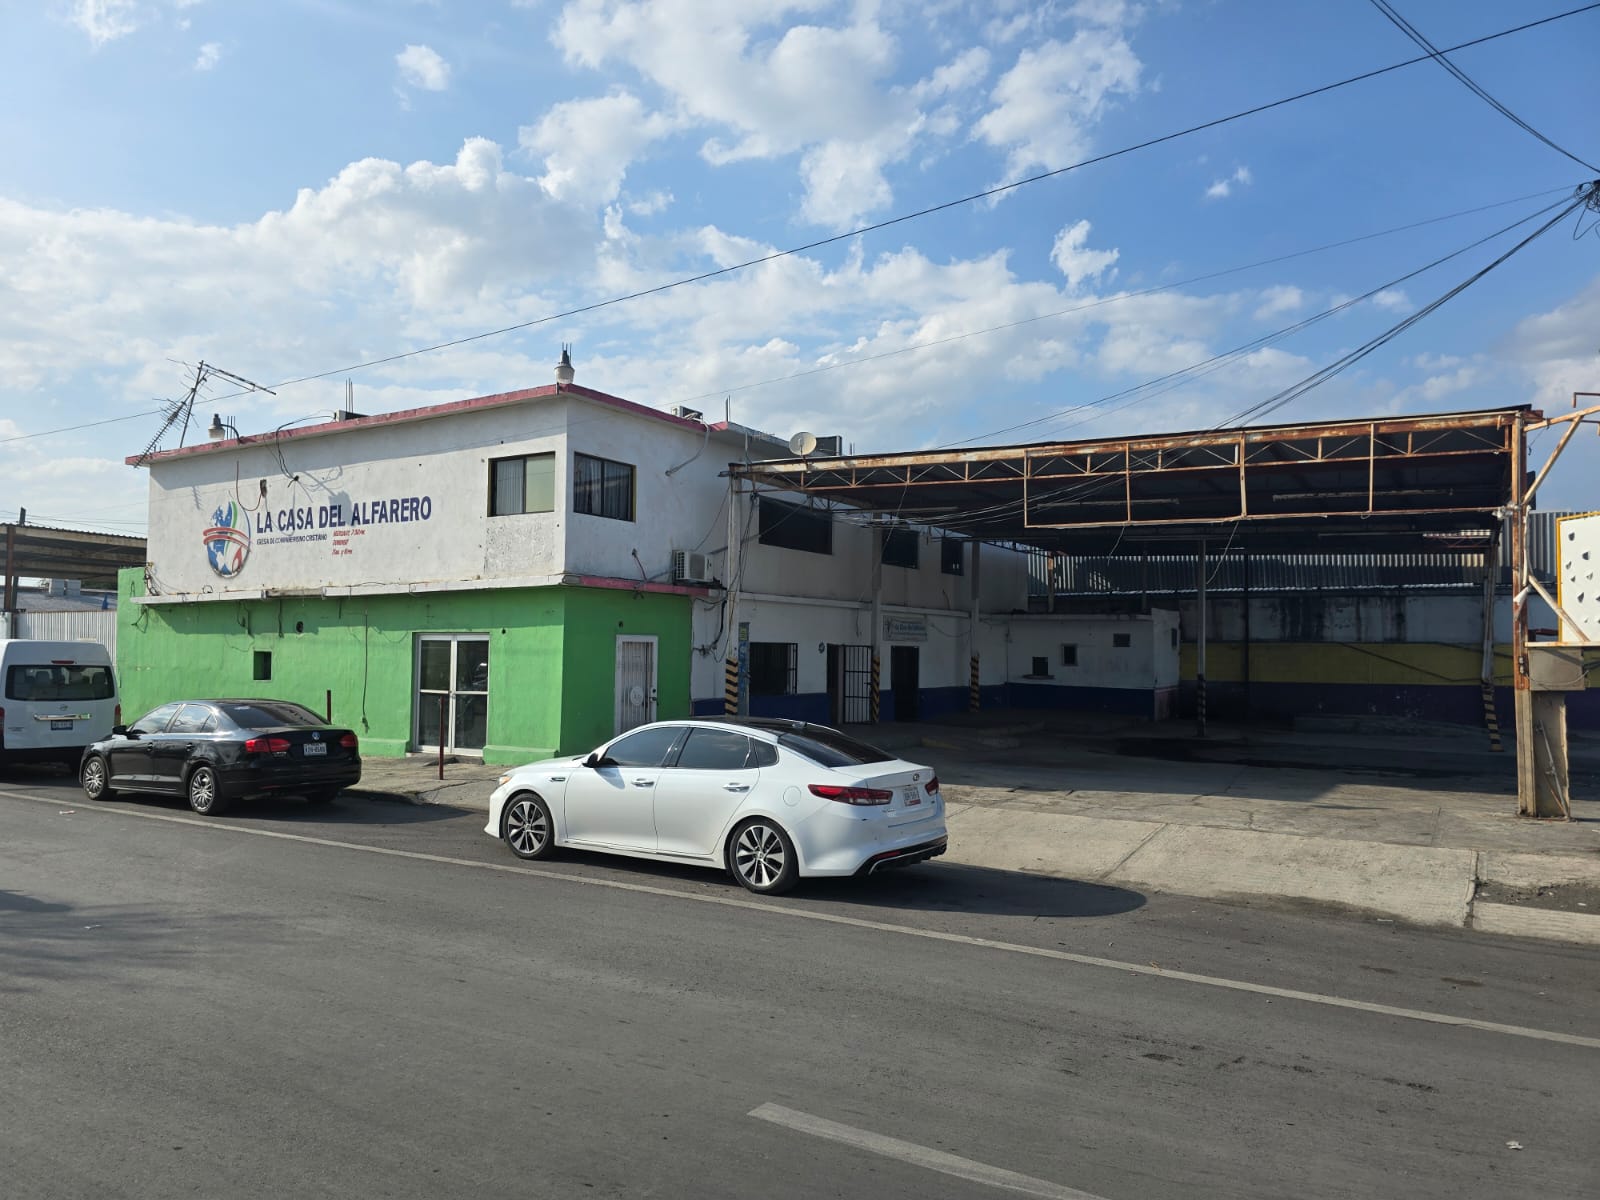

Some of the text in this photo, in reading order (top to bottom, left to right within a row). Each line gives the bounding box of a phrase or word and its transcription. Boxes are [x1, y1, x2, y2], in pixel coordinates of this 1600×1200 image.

[257, 496, 432, 533] LA CASA DEL ALFARERO
